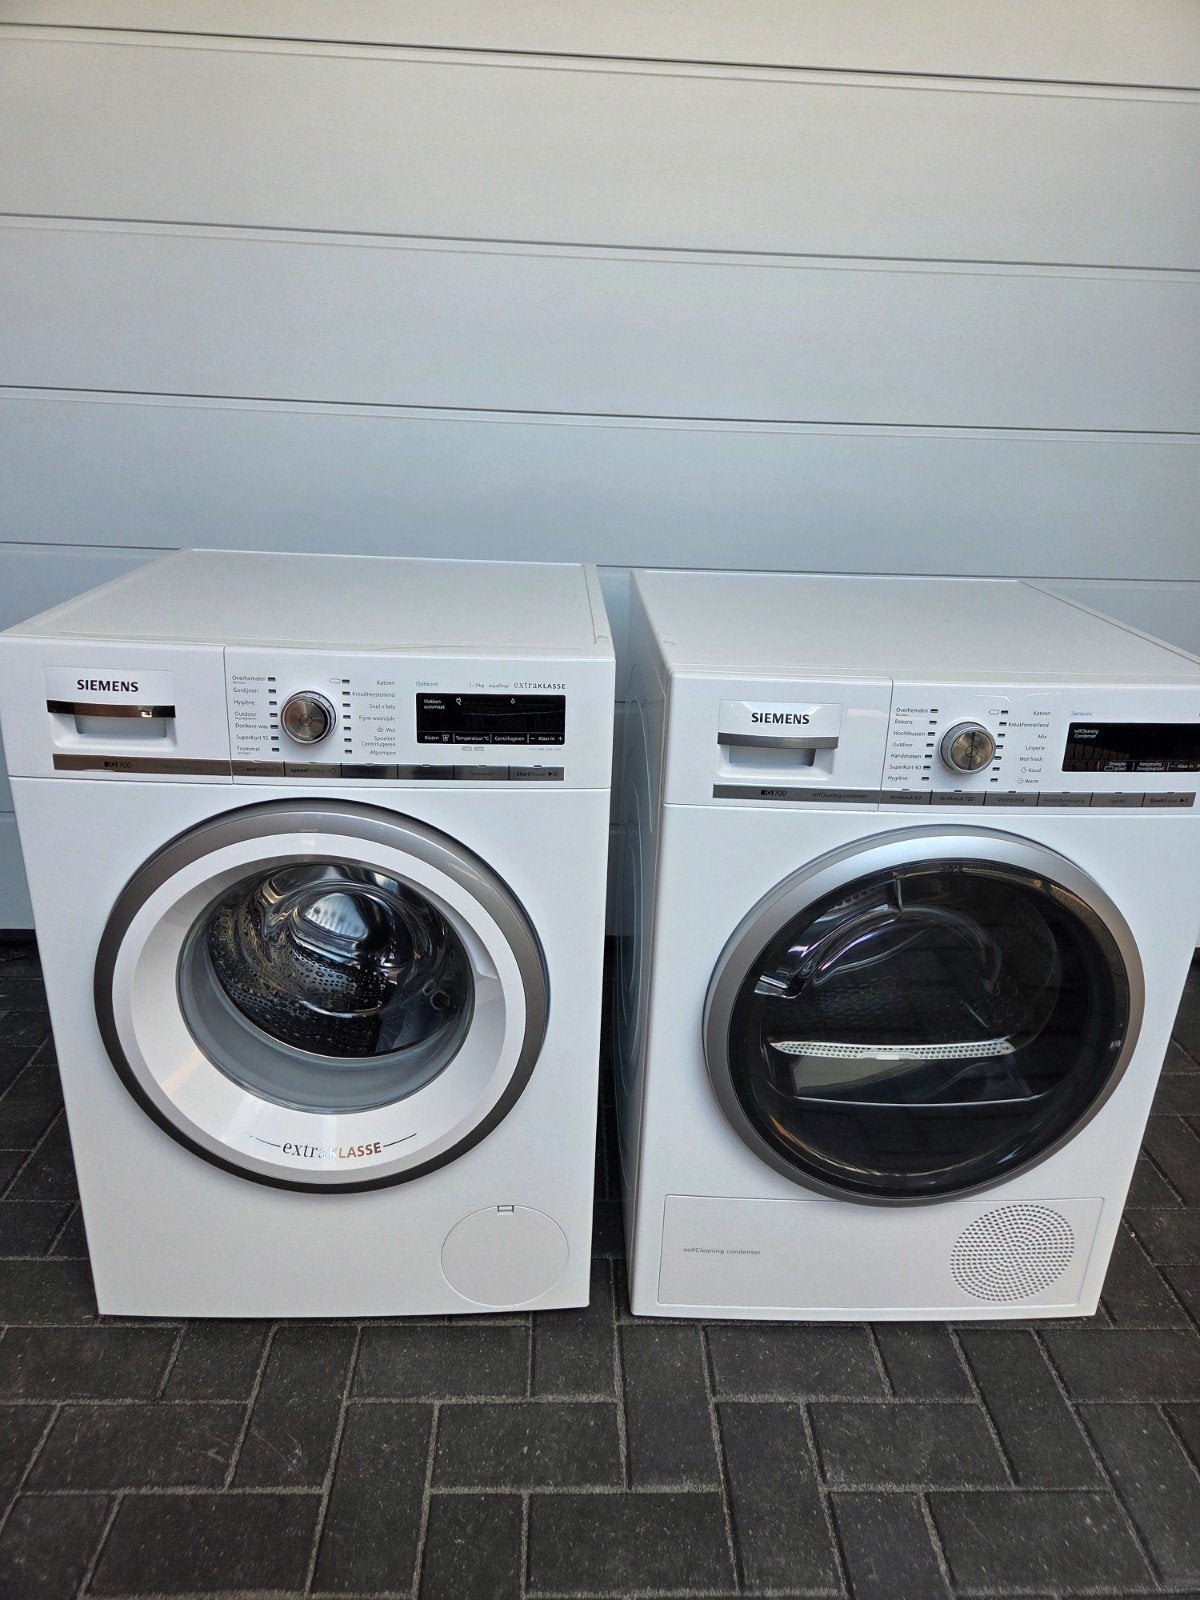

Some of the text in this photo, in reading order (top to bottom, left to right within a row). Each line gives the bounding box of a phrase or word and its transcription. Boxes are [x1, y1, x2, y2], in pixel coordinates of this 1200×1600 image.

[76, 679, 139, 693] SIEMENS
[514, 682, 566, 690] extraKLASSE
[752, 712, 810, 725] SIEMENS
